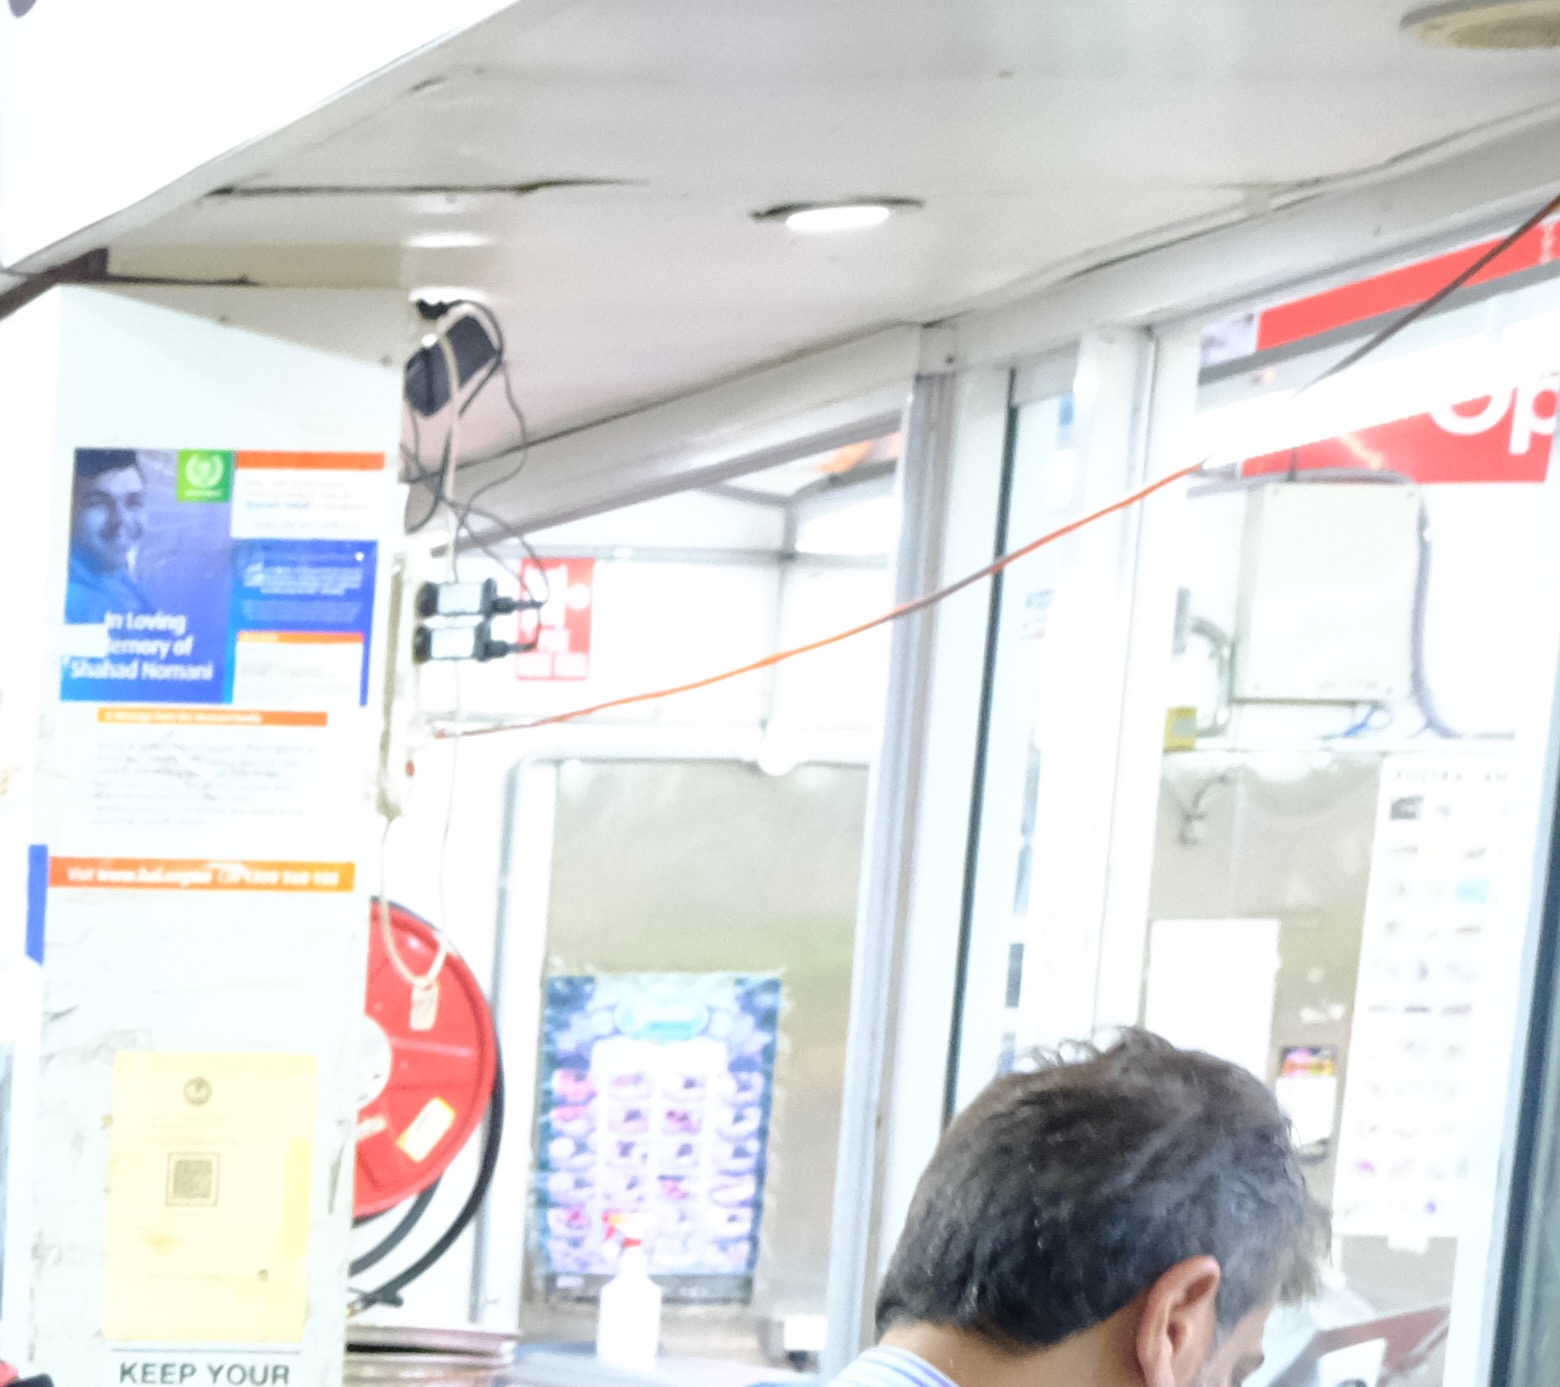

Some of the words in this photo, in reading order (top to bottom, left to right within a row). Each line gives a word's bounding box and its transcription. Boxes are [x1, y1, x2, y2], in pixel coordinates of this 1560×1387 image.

[126, 611, 187, 637] Loving
[109, 639, 170, 659] emory
[172, 635, 194, 656] of
[119, 1362, 196, 1385] KEEP
[207, 1363, 290, 1386] YOUR
